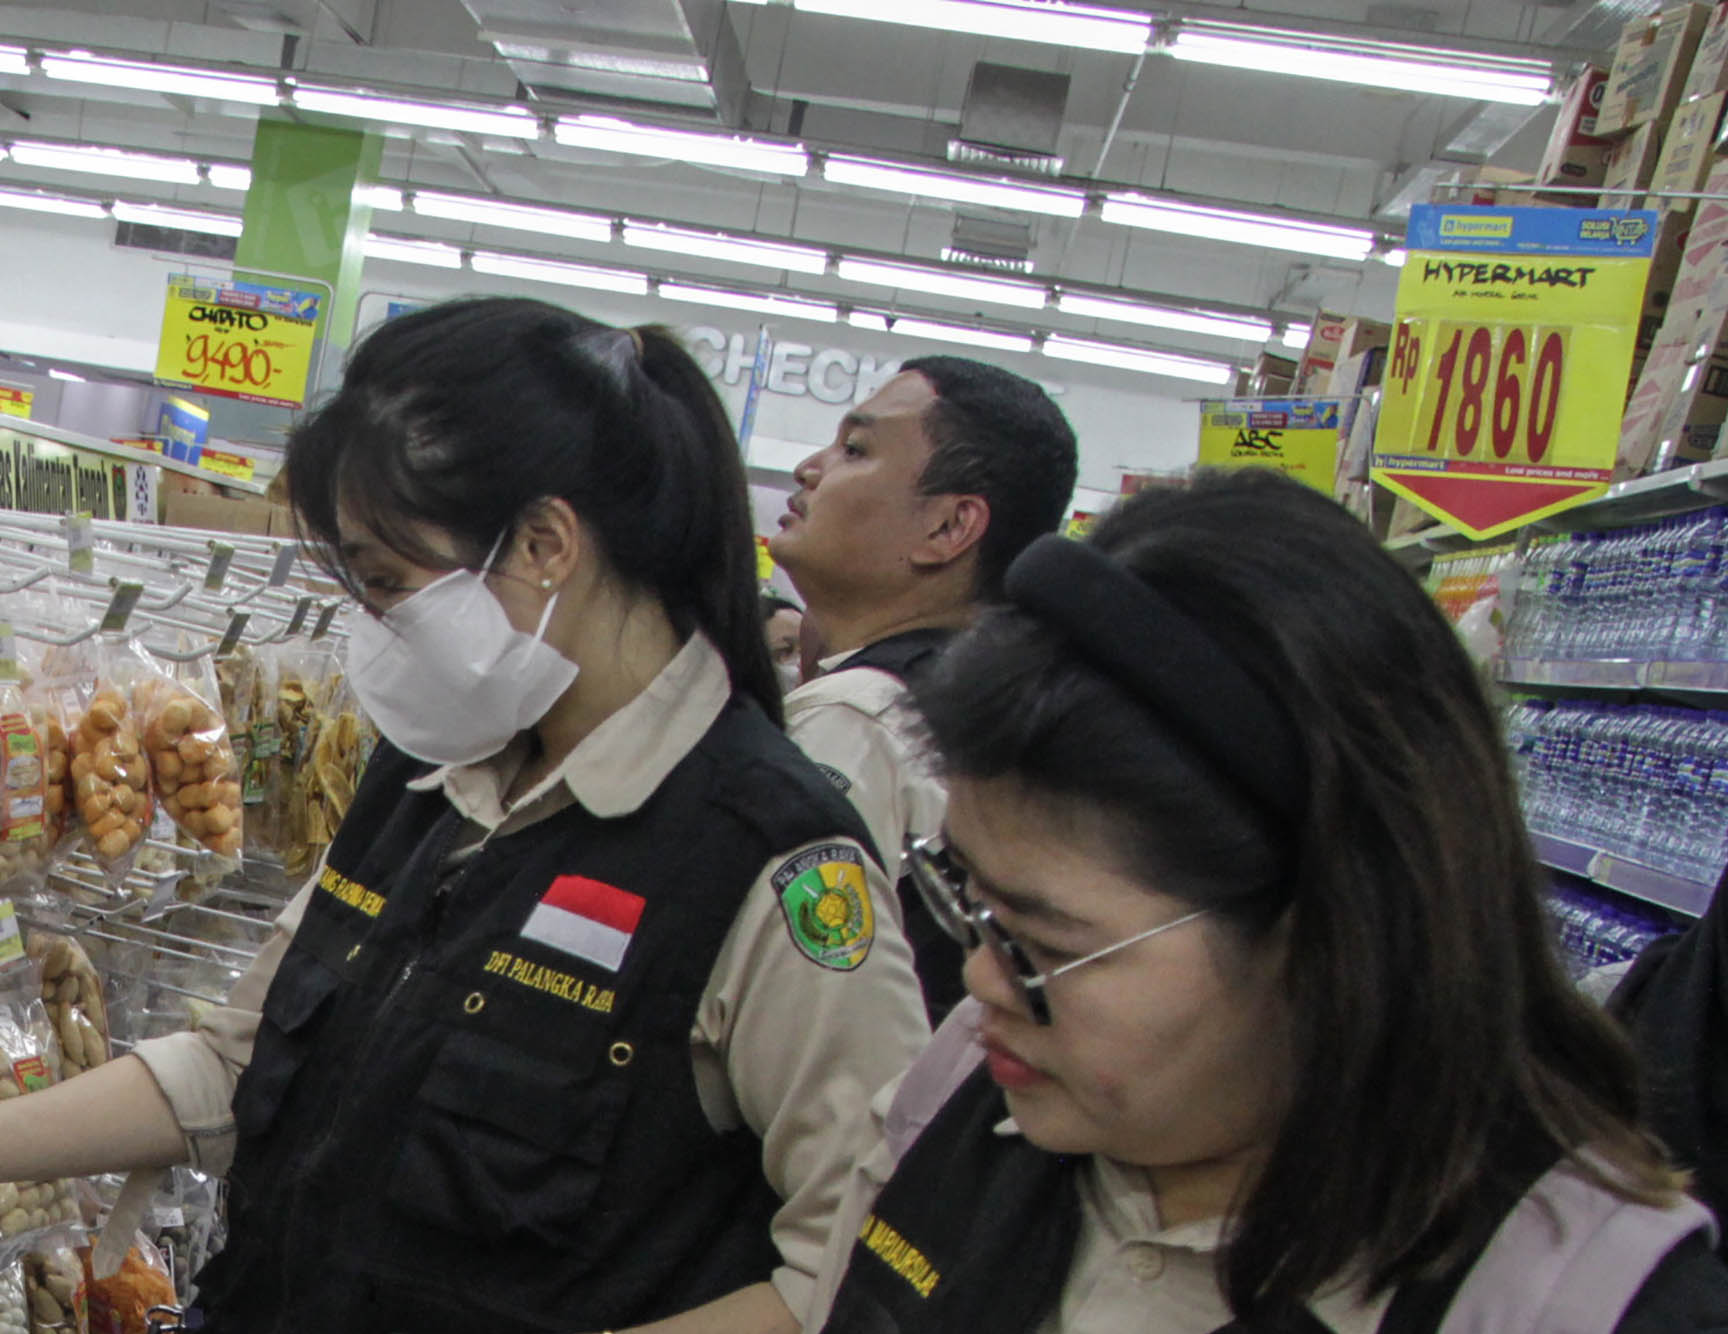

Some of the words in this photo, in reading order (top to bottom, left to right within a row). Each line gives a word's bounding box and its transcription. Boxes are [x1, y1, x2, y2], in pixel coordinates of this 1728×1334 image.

[1423, 259, 1596, 289] HYPERMART
[1390, 325, 1421, 396] Rp
[1426, 326, 1563, 464] 1860
[1233, 428, 1284, 451] ABC
[510, 956, 584, 1003] PALANGKA
